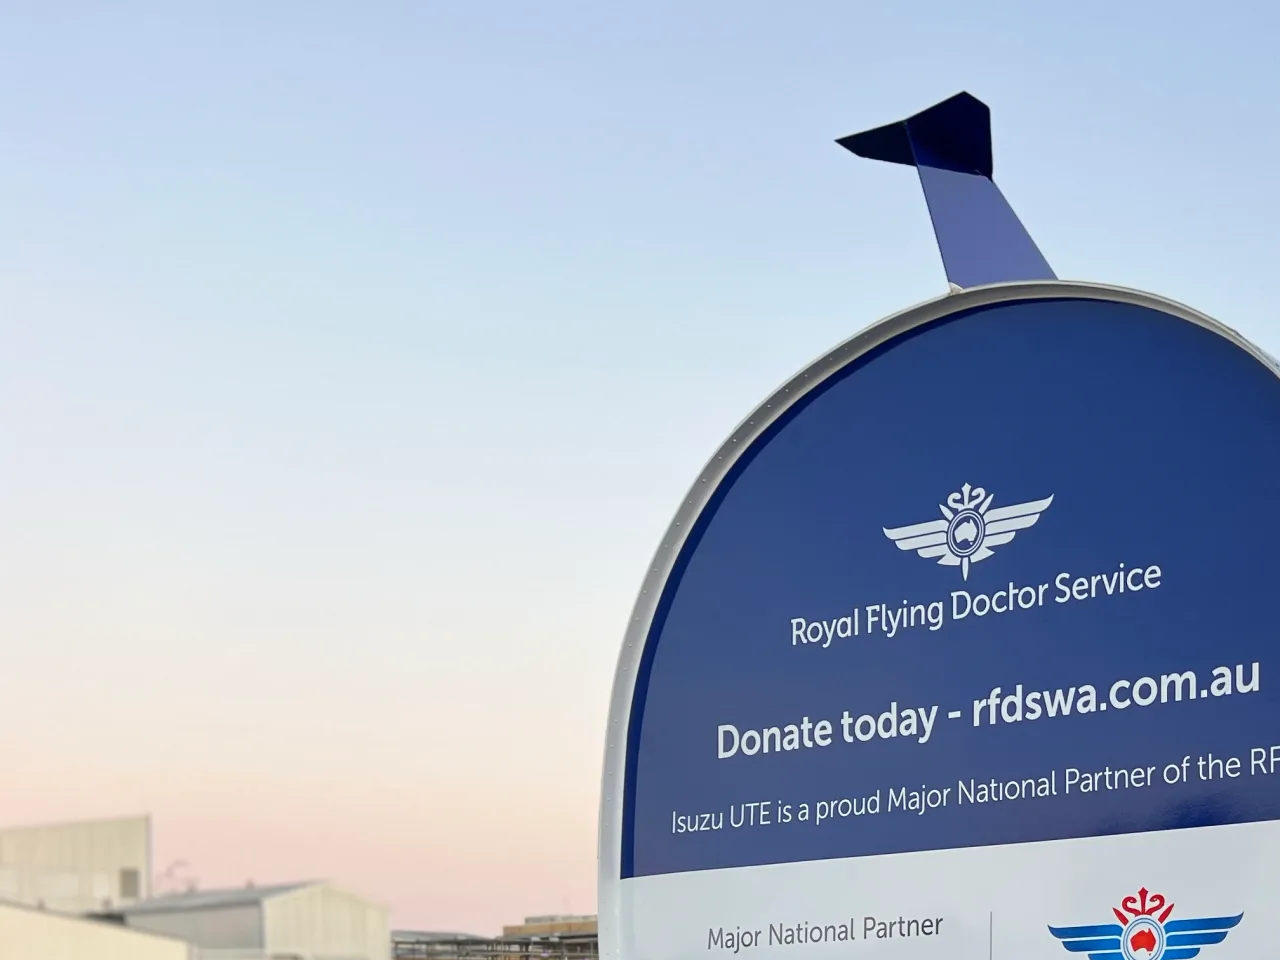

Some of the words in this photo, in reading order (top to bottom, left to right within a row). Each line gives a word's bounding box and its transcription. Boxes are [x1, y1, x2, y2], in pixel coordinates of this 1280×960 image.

[790, 609, 860, 649] Royal
[865, 601, 944, 638] Flying
[950, 581, 1049, 620] Doctor
[1054, 562, 1162, 604] Service
[717, 716, 833, 759] Donate
[840, 702, 939, 745] today
[973, 661, 1260, 727] rfdswa.com.au
[672, 810, 724, 834] Isuzu
[730, 801, 772, 828] UTE
[777, 800, 792, 824] is
[797, 803, 809, 822] a
[816, 789, 880, 826] proud
[887, 786, 952, 817] Major
[958, 770, 1058, 805] National
[1065, 766, 1156, 795] Partner
[1163, 755, 1191, 784] of
[1197, 753, 1241, 781] the
[707, 927, 762, 955] Major
[768, 917, 856, 946] National
[863, 916, 944, 940] Partner
